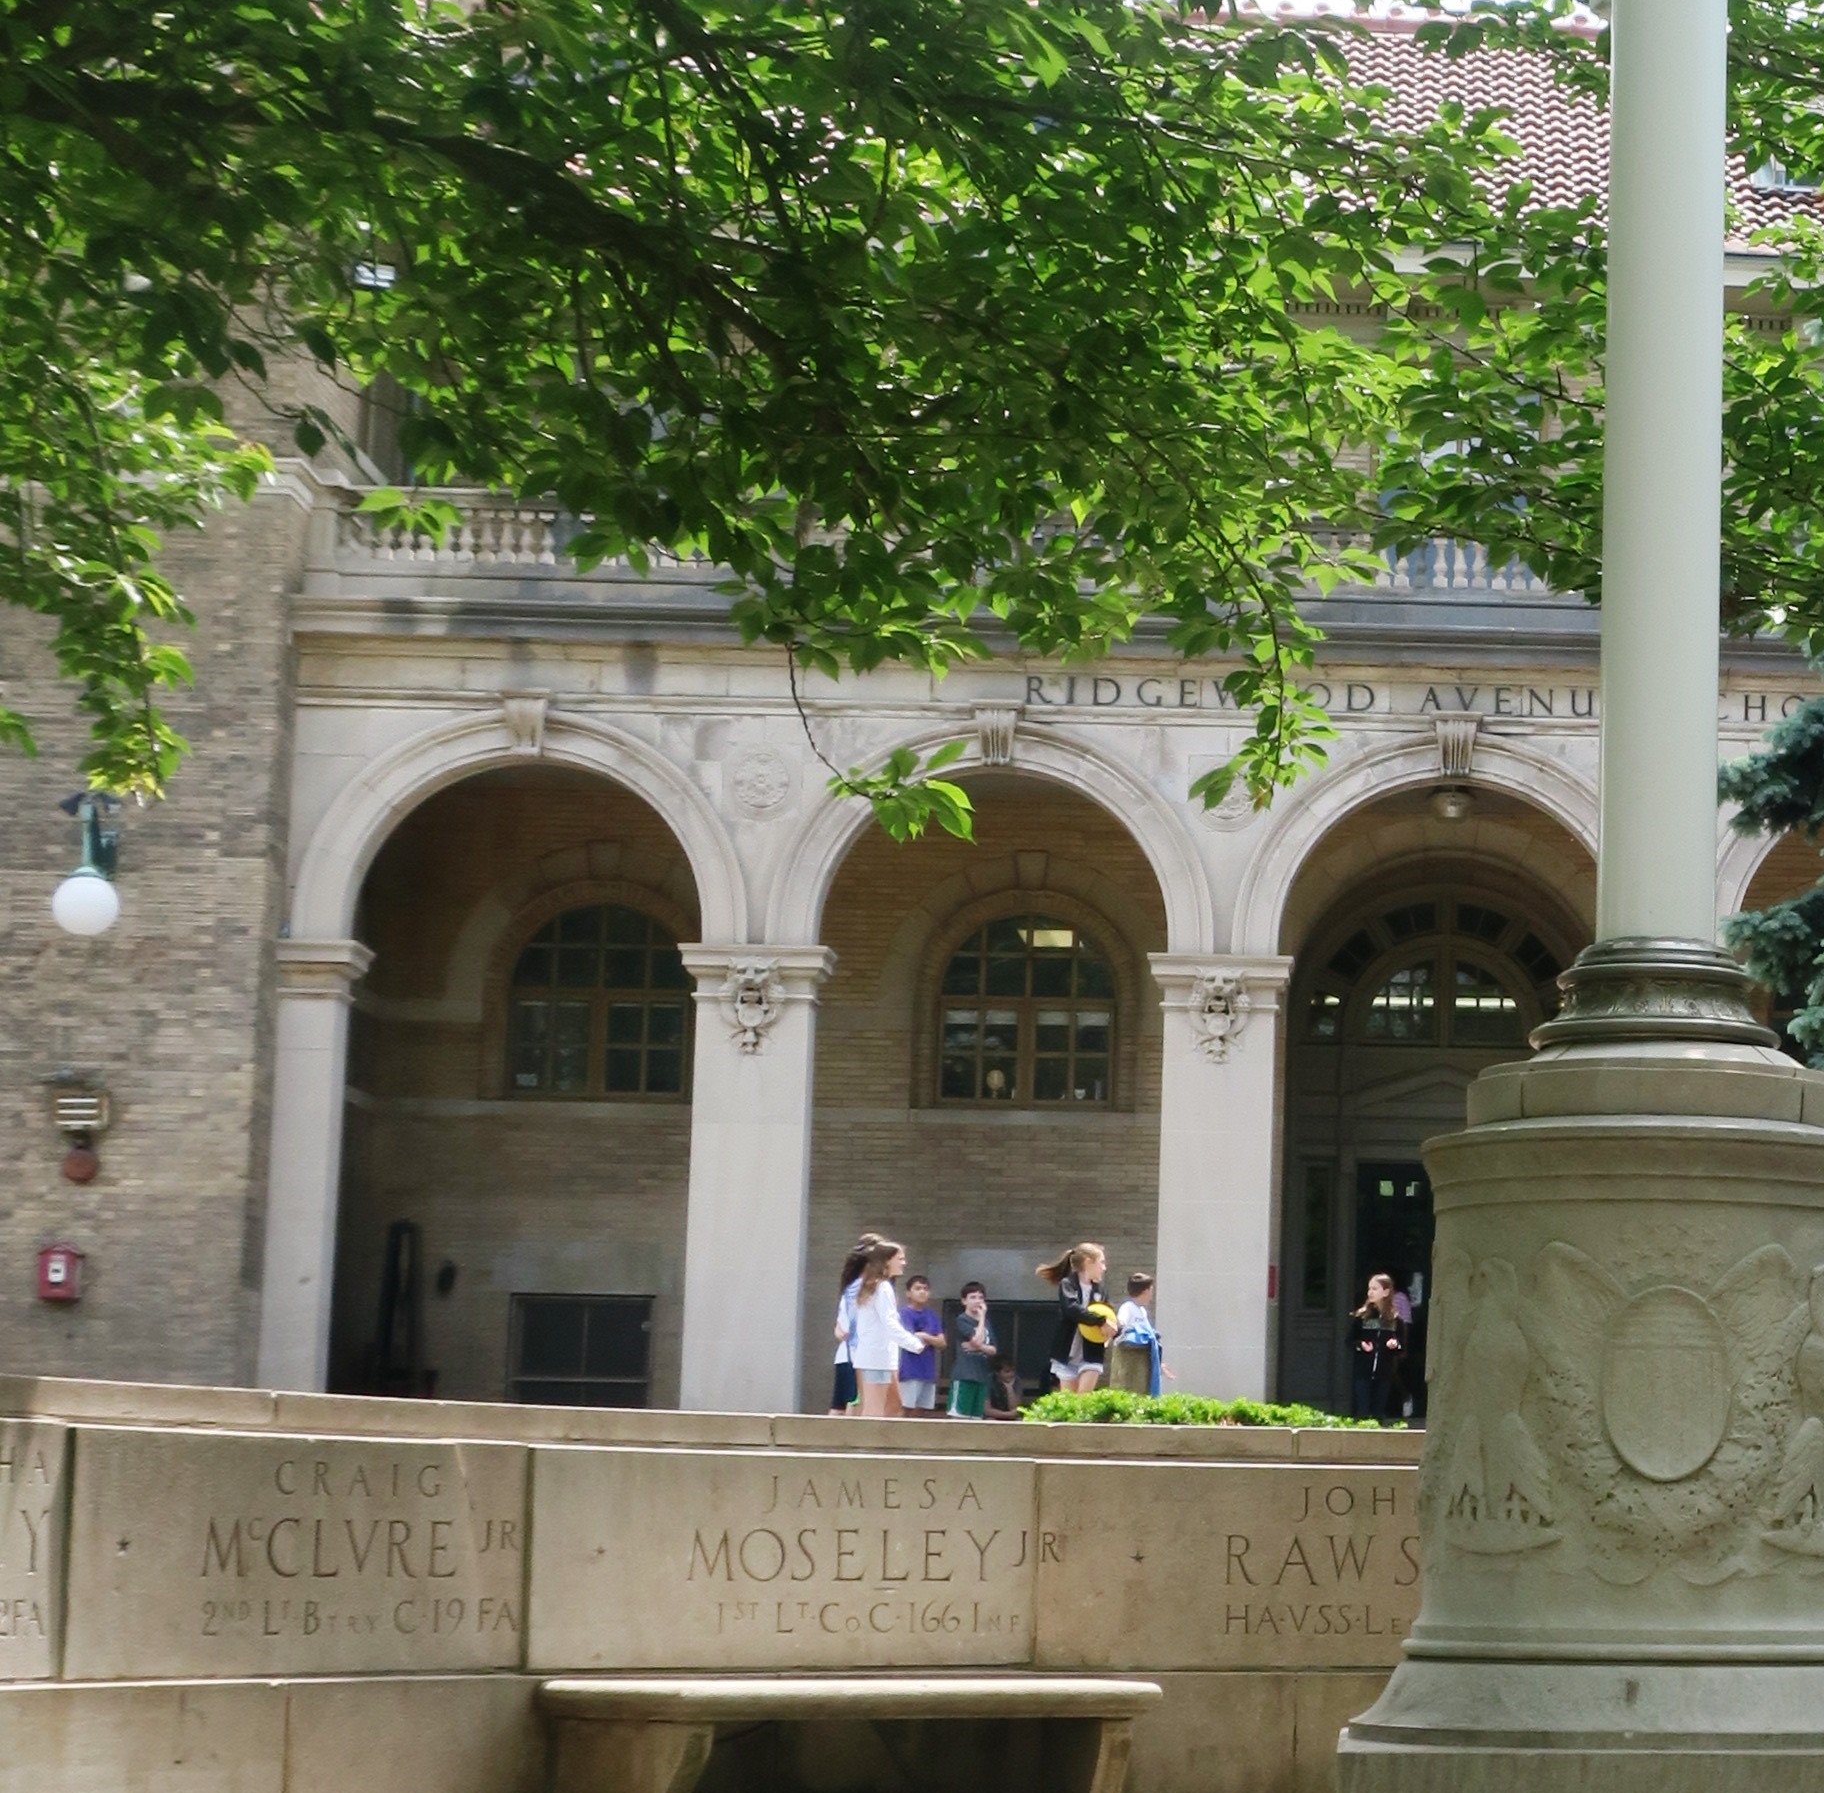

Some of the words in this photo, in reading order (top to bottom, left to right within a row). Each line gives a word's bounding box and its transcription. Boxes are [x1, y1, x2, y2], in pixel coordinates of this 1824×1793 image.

[1025, 675, 1375, 712] RIDGEWOD
[1419, 686, 1594, 717] AVENU
[274, 1460, 441, 1498] CRAIG
[762, 1475, 936, 1514] JAMES
[1297, 1486, 1418, 1522] JOH
[478, 1519, 521, 1553] JR
[686, 1528, 1002, 1582] MOSELEY
[1012, 1530, 1061, 1567] JR
